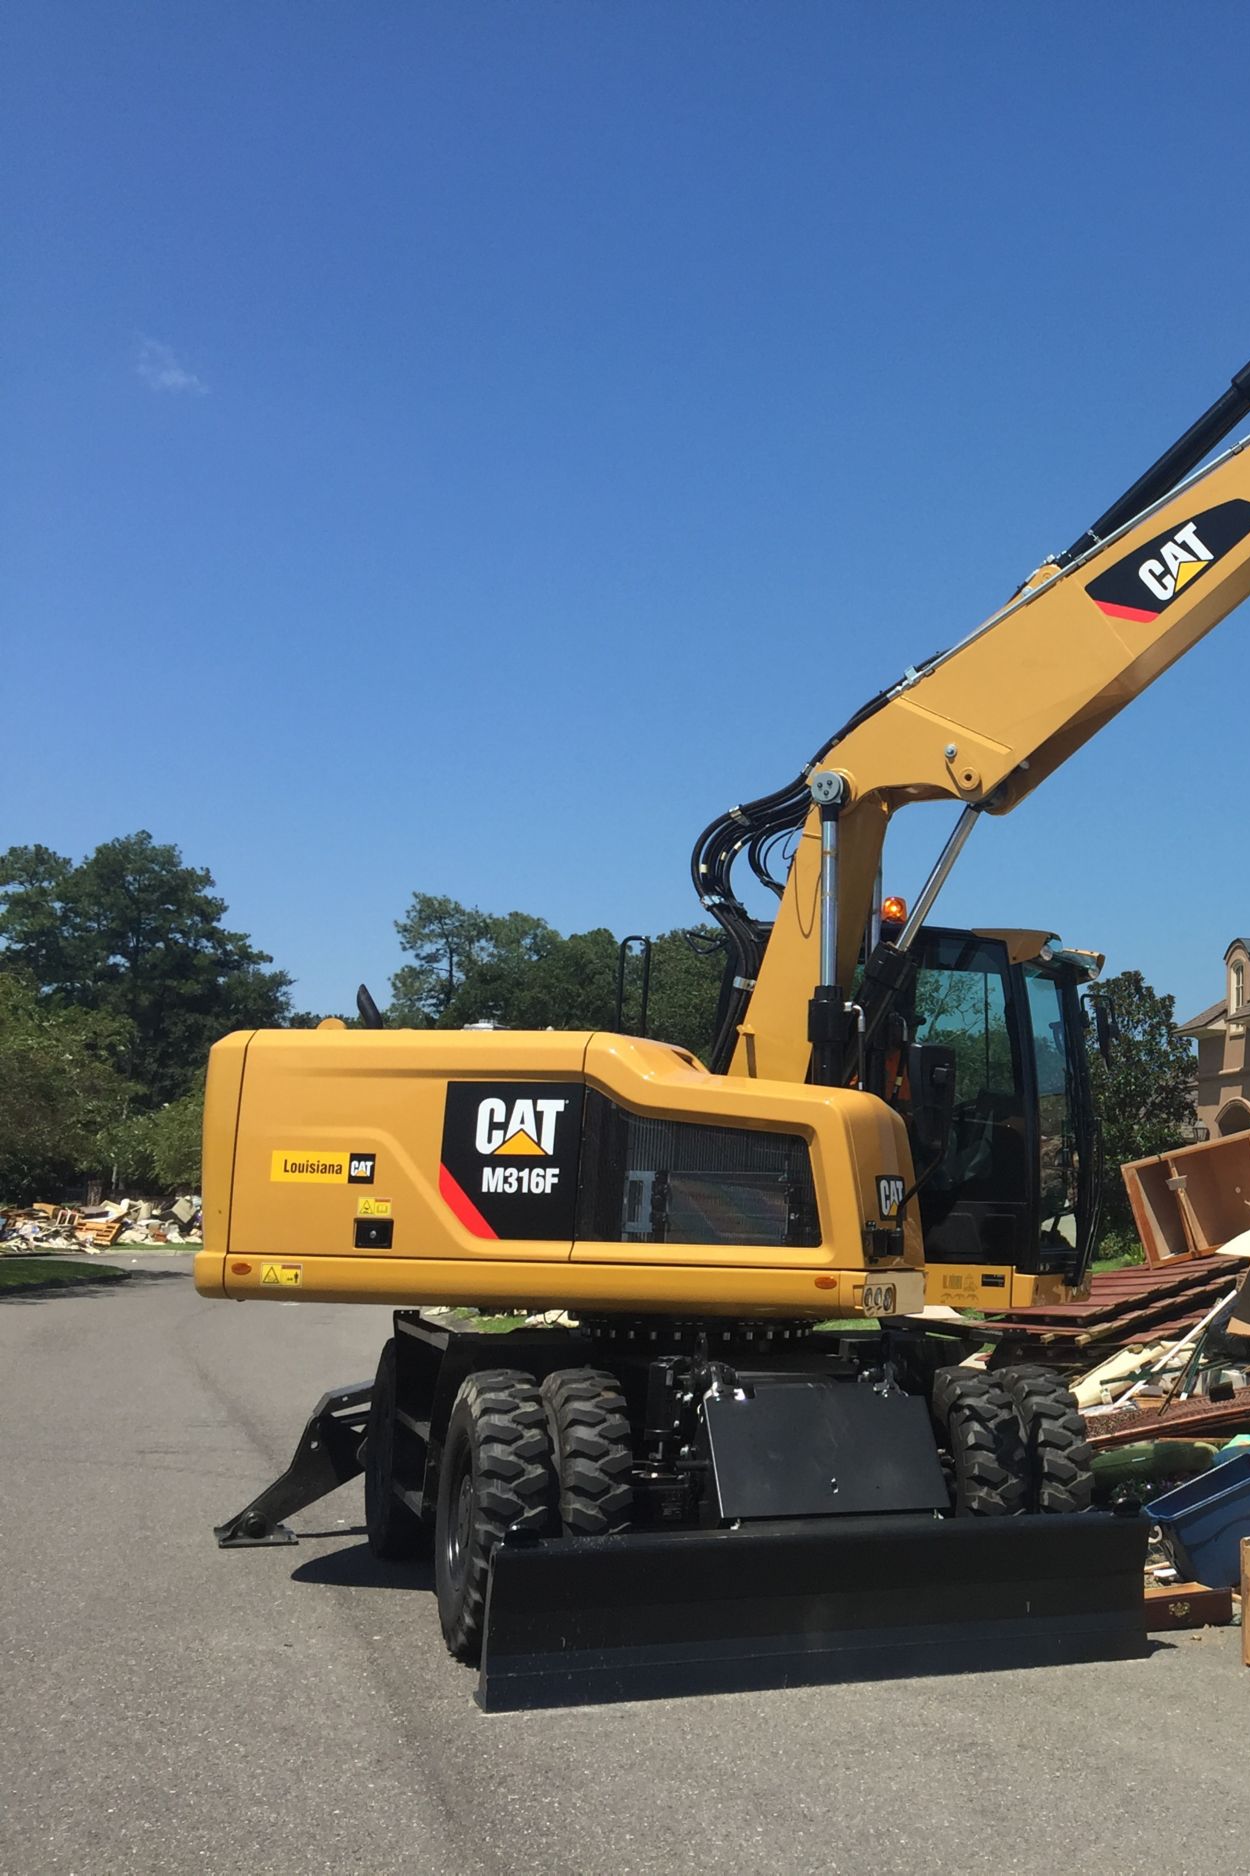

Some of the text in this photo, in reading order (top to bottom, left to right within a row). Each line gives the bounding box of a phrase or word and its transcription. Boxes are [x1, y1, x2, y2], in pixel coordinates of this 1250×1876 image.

[1138, 521, 1215, 601] CAT
[475, 1098, 565, 1156] CAT
[283, 1159, 374, 1177] Louisiana CAT
[481, 1166, 560, 1194] M316F
[880, 1179, 904, 1216] CAT
